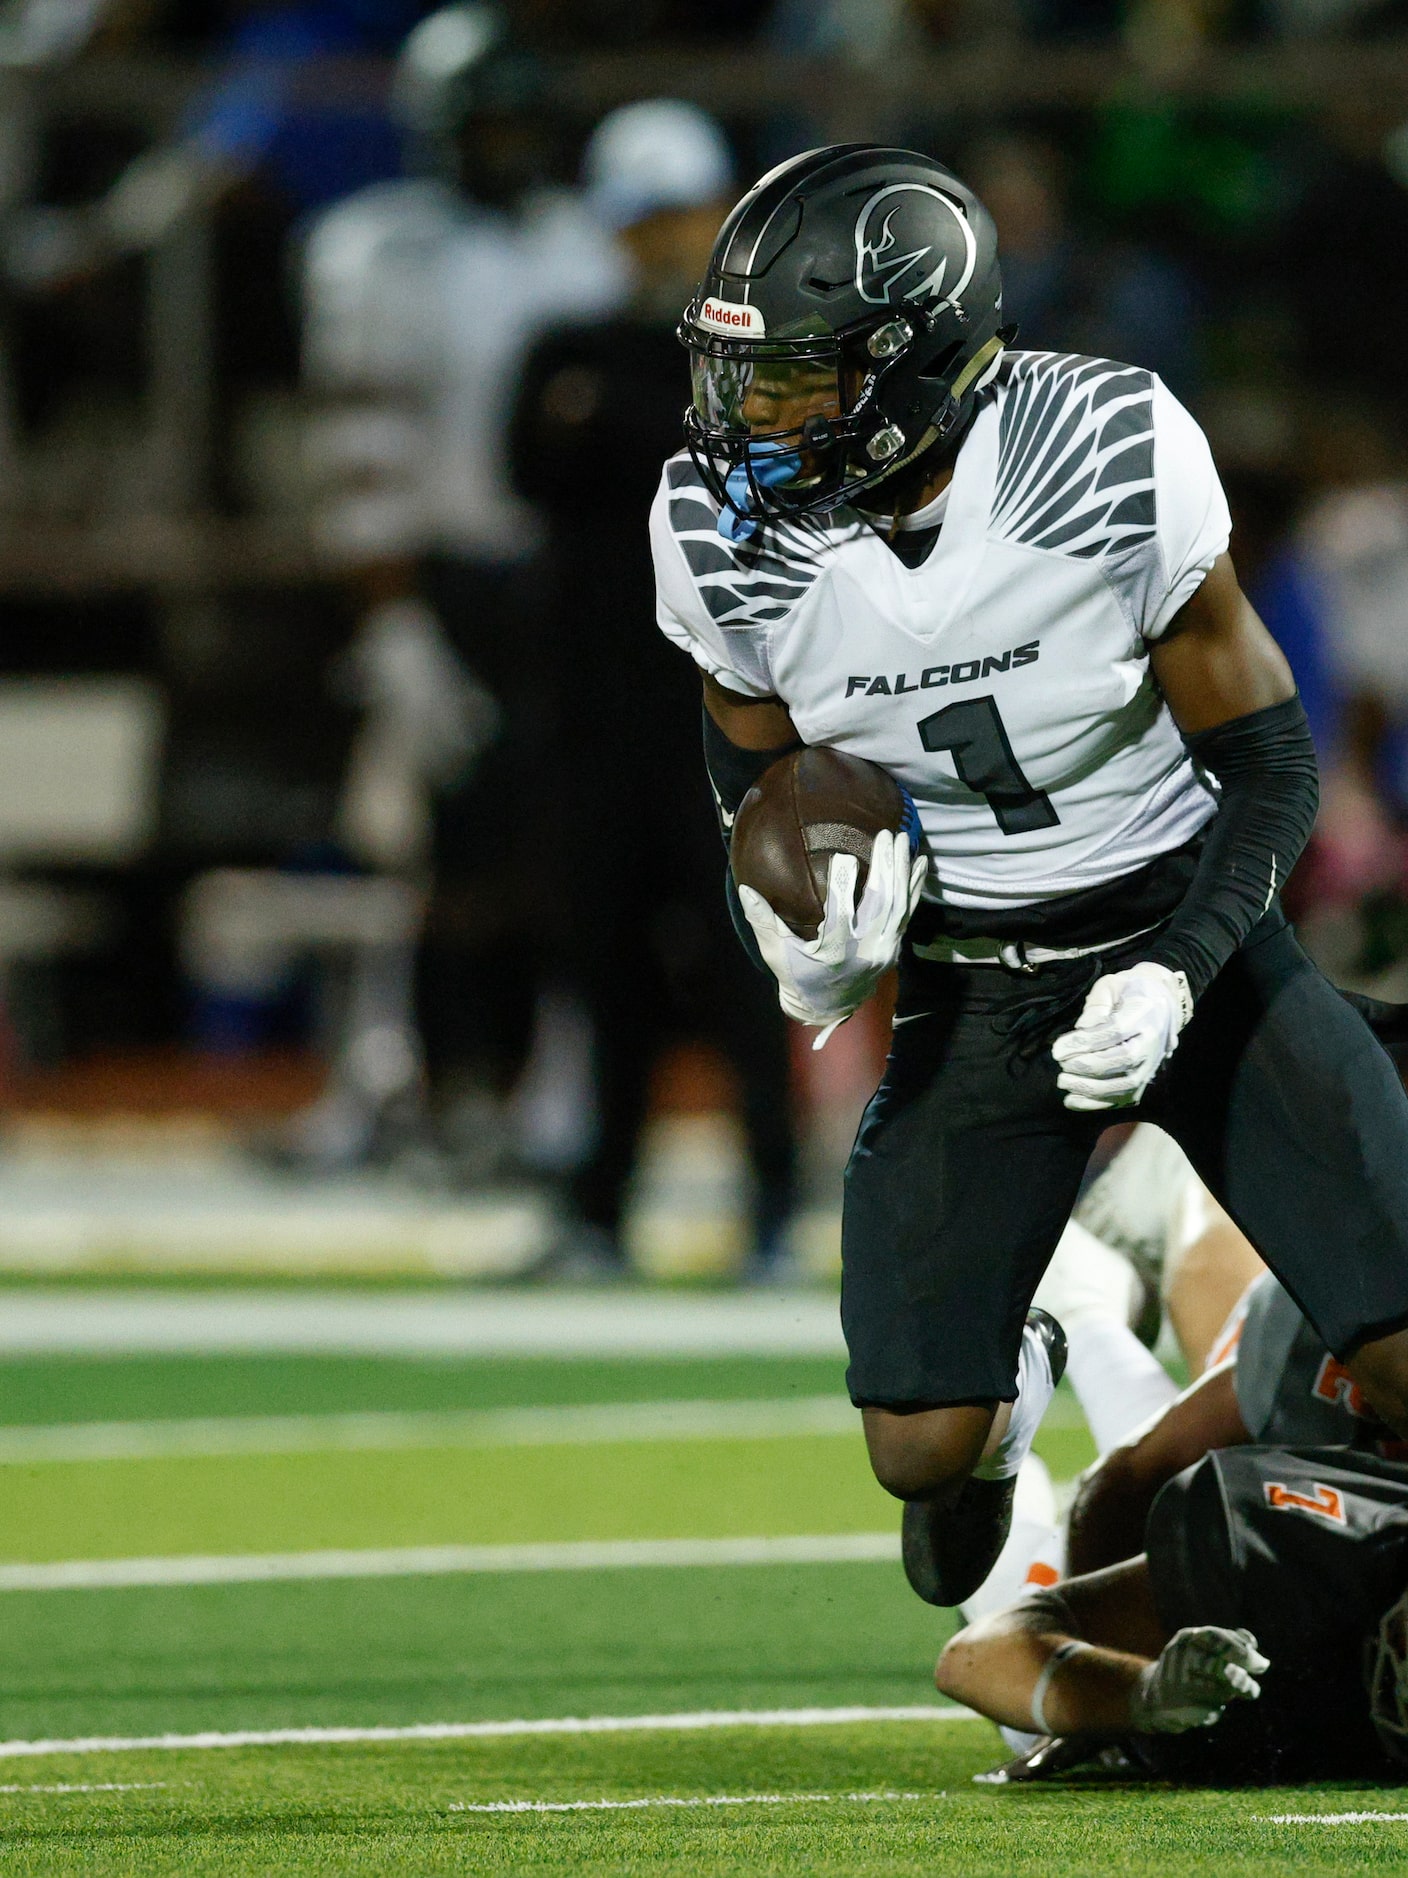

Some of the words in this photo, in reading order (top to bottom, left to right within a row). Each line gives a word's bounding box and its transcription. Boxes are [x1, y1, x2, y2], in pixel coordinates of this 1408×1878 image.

[704, 303, 751, 328] Riddell
[844, 639, 1041, 699] FALCONS
[916, 694, 1062, 836] 1
[1262, 1481, 1348, 1526] 7
